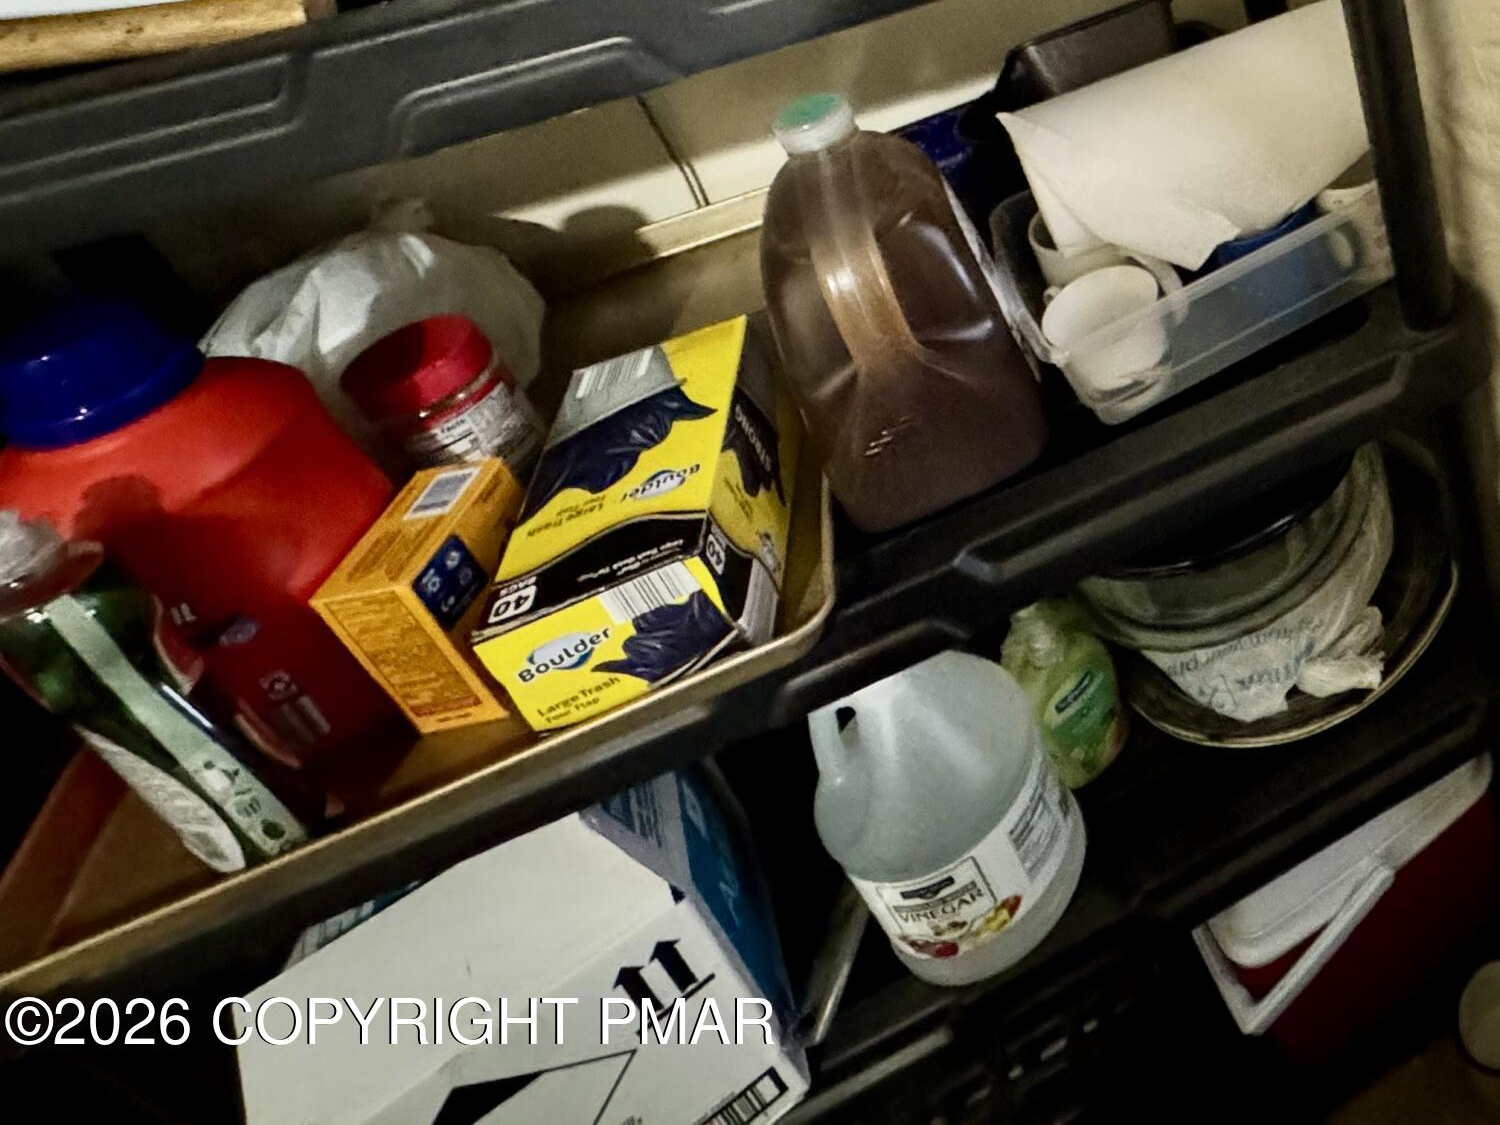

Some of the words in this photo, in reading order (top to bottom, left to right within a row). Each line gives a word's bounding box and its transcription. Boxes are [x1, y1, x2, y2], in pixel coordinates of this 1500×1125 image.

[621, 463, 701, 502] Boulder
[493, 593, 531, 616] 40
[518, 627, 611, 682] Boulder
[537, 689, 580, 718] Large
[580, 676, 621, 702] Trash
[900, 887, 985, 924] VINEGAR
